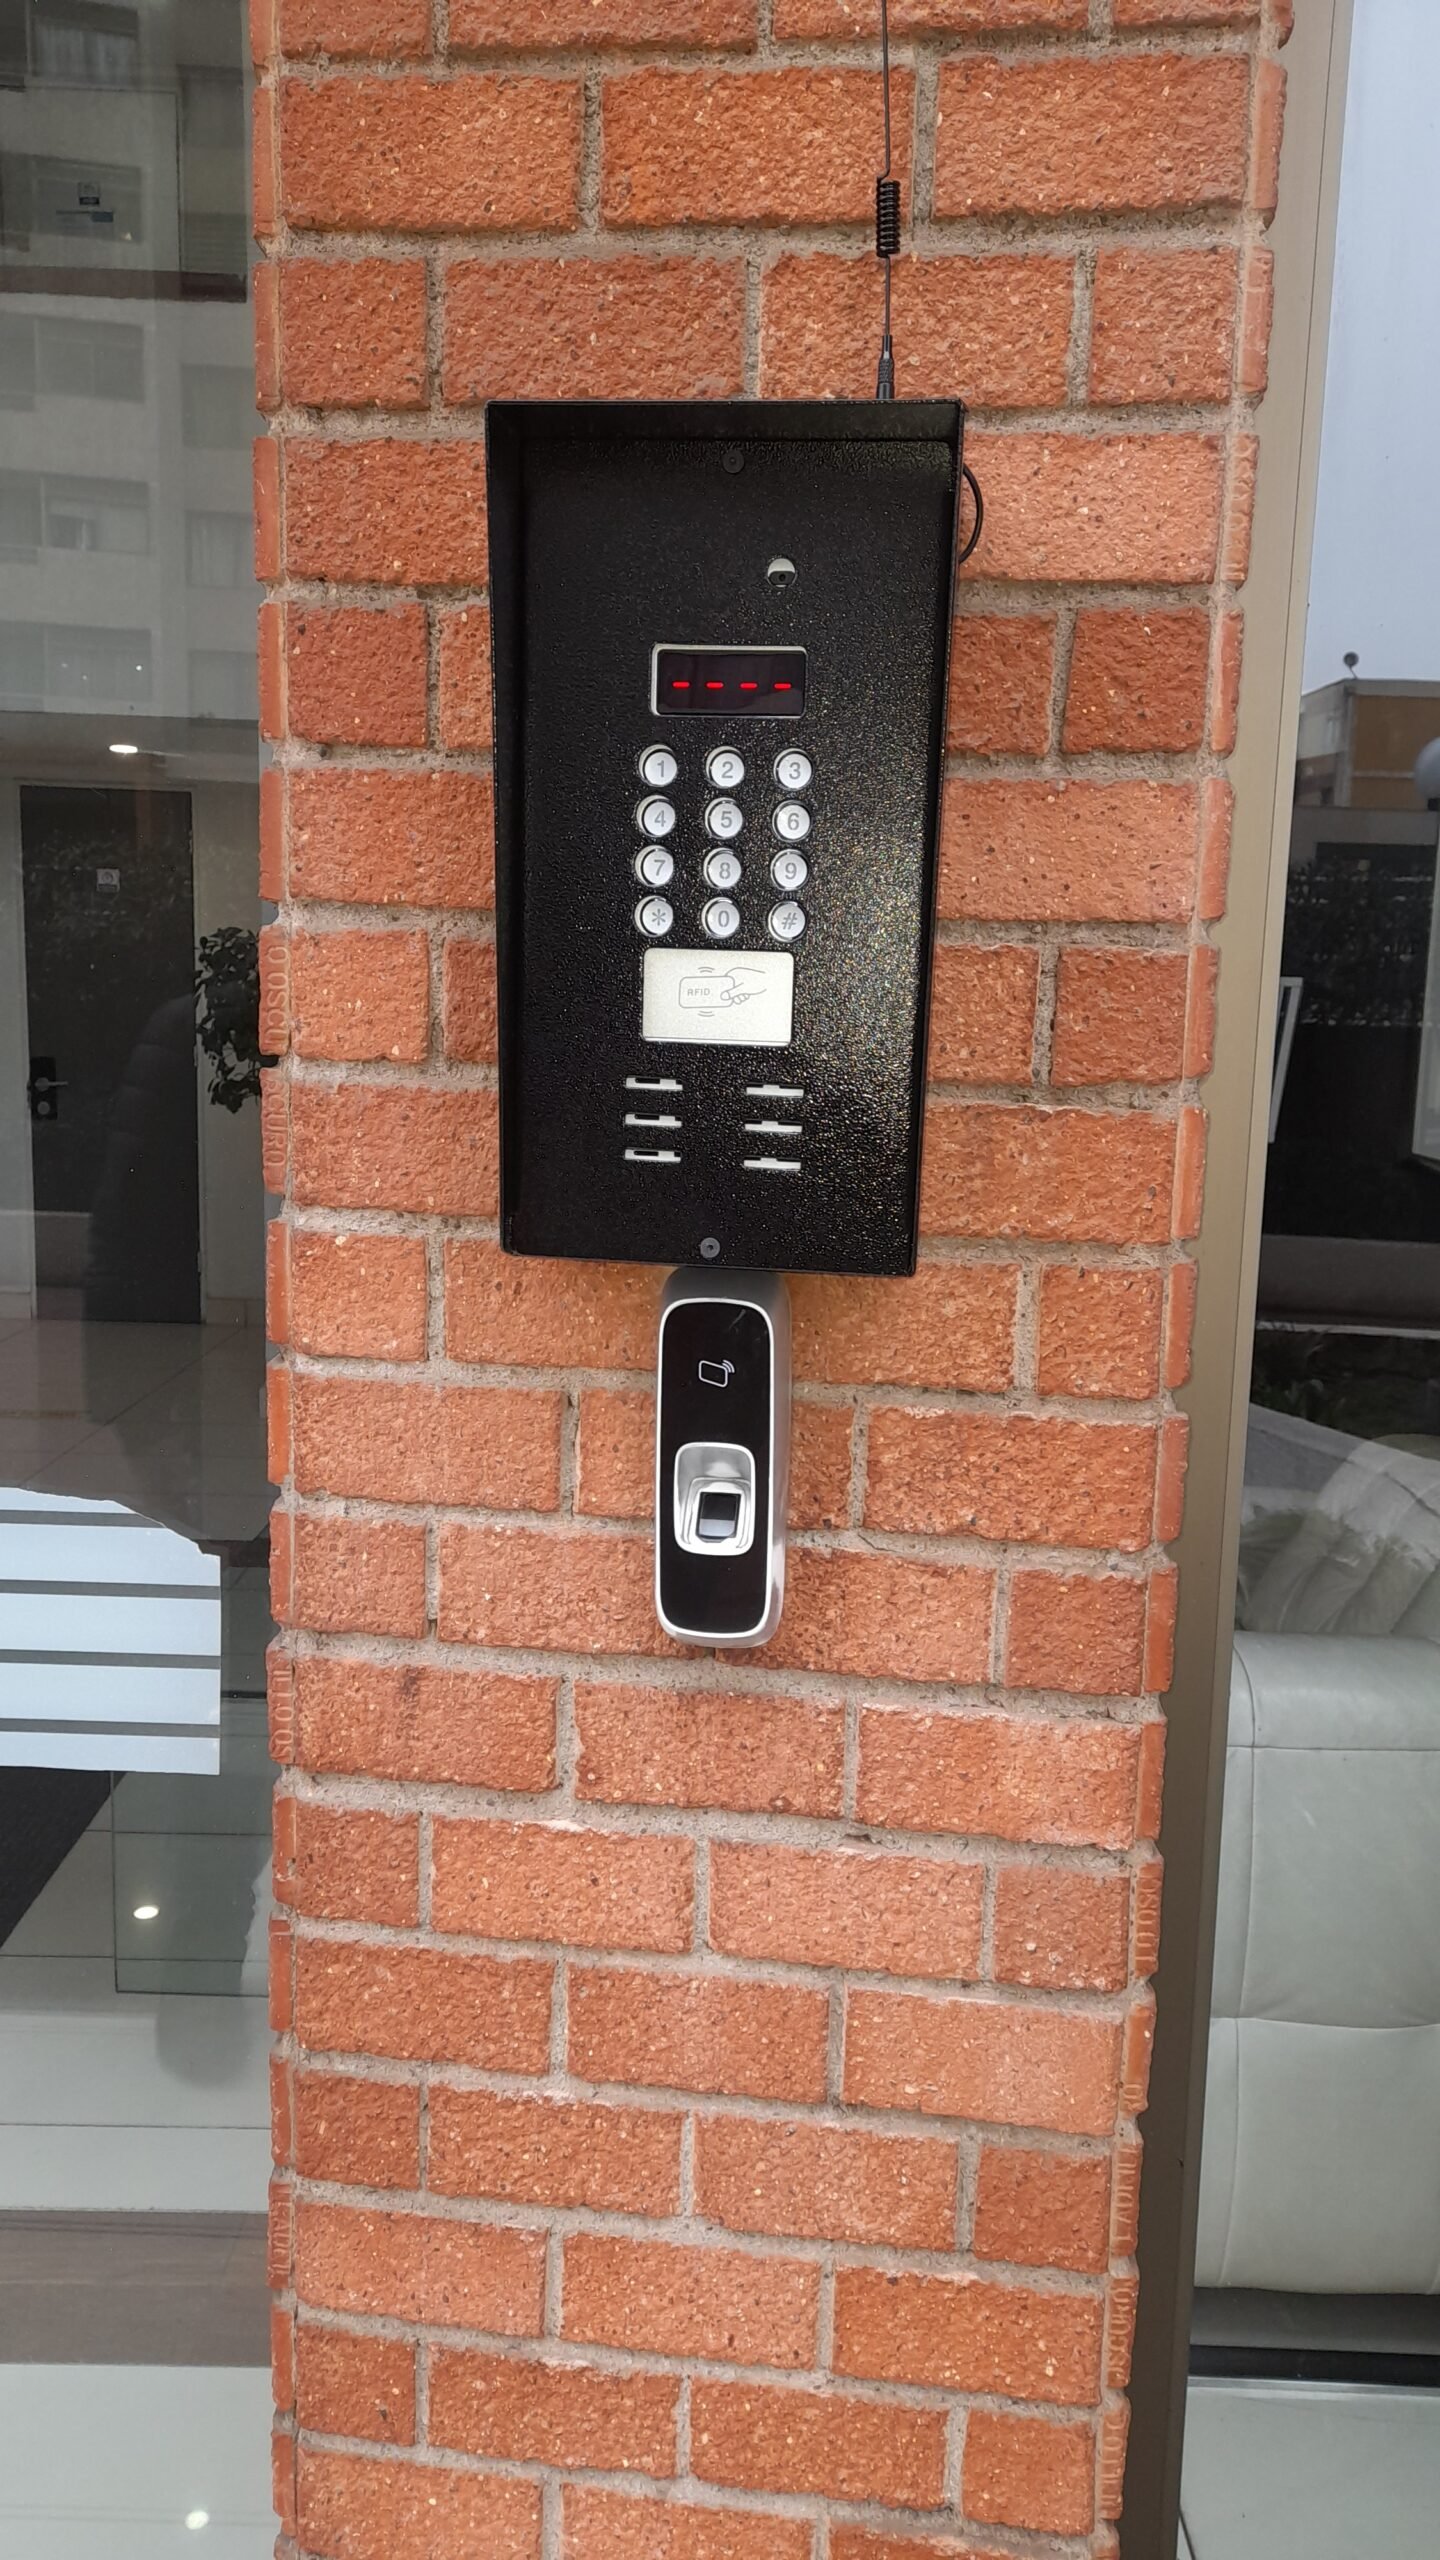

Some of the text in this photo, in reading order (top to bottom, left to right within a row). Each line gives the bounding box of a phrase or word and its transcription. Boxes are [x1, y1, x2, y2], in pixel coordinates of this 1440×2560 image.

[657, 760, 665, 777] 1
[721, 762, 733, 778] 2
[789, 762, 801, 779] 3
[654, 810, 666, 827] 4
[721, 811, 732, 828] 5
[787, 813, 799, 830] 6
[654, 860, 666, 876] 7
[719, 862, 730, 879] 8
[785, 863, 797, 880] 9
[718, 910, 729, 927] 0
[687, 988, 711, 997] RFID
